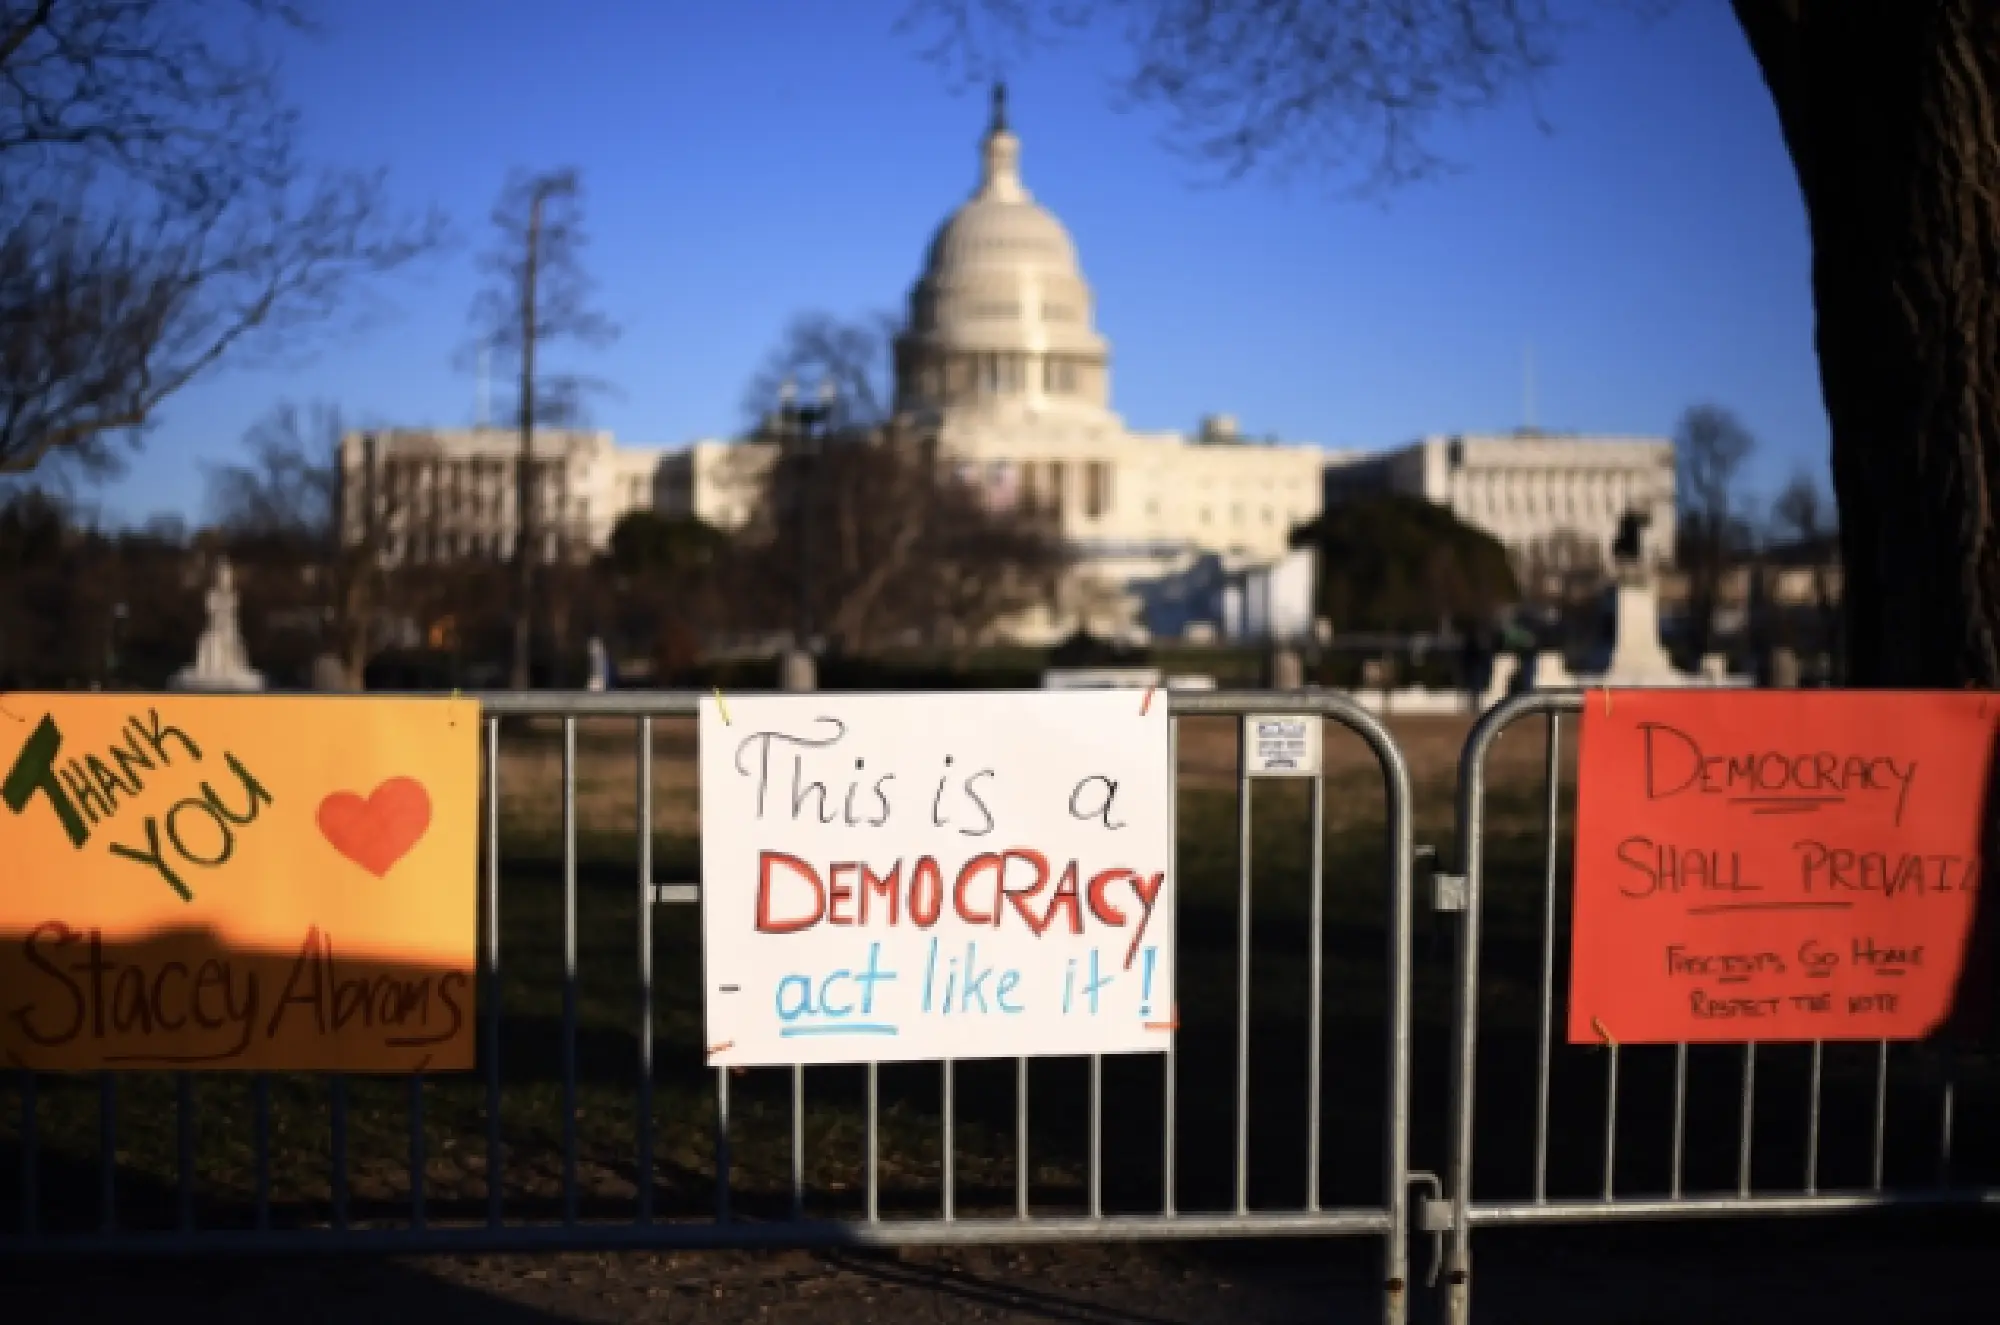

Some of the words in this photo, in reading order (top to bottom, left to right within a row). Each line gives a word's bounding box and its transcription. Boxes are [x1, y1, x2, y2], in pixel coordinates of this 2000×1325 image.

[2, 707, 202, 849] THANK
[110, 751, 273, 902] YOU
[735, 716, 896, 827] This
[932, 754, 995, 836] is
[1068, 775, 1127, 830] a
[1637, 721, 1917, 826] DEMOCRACY
[754, 847, 1165, 970] DEMOCRACY
[1617, 835, 1764, 898] SHALL
[8, 920, 260, 1061] Stacey
[267, 923, 468, 1047] Abrams
[775, 941, 898, 1020] act
[921, 937, 1025, 1016] like
